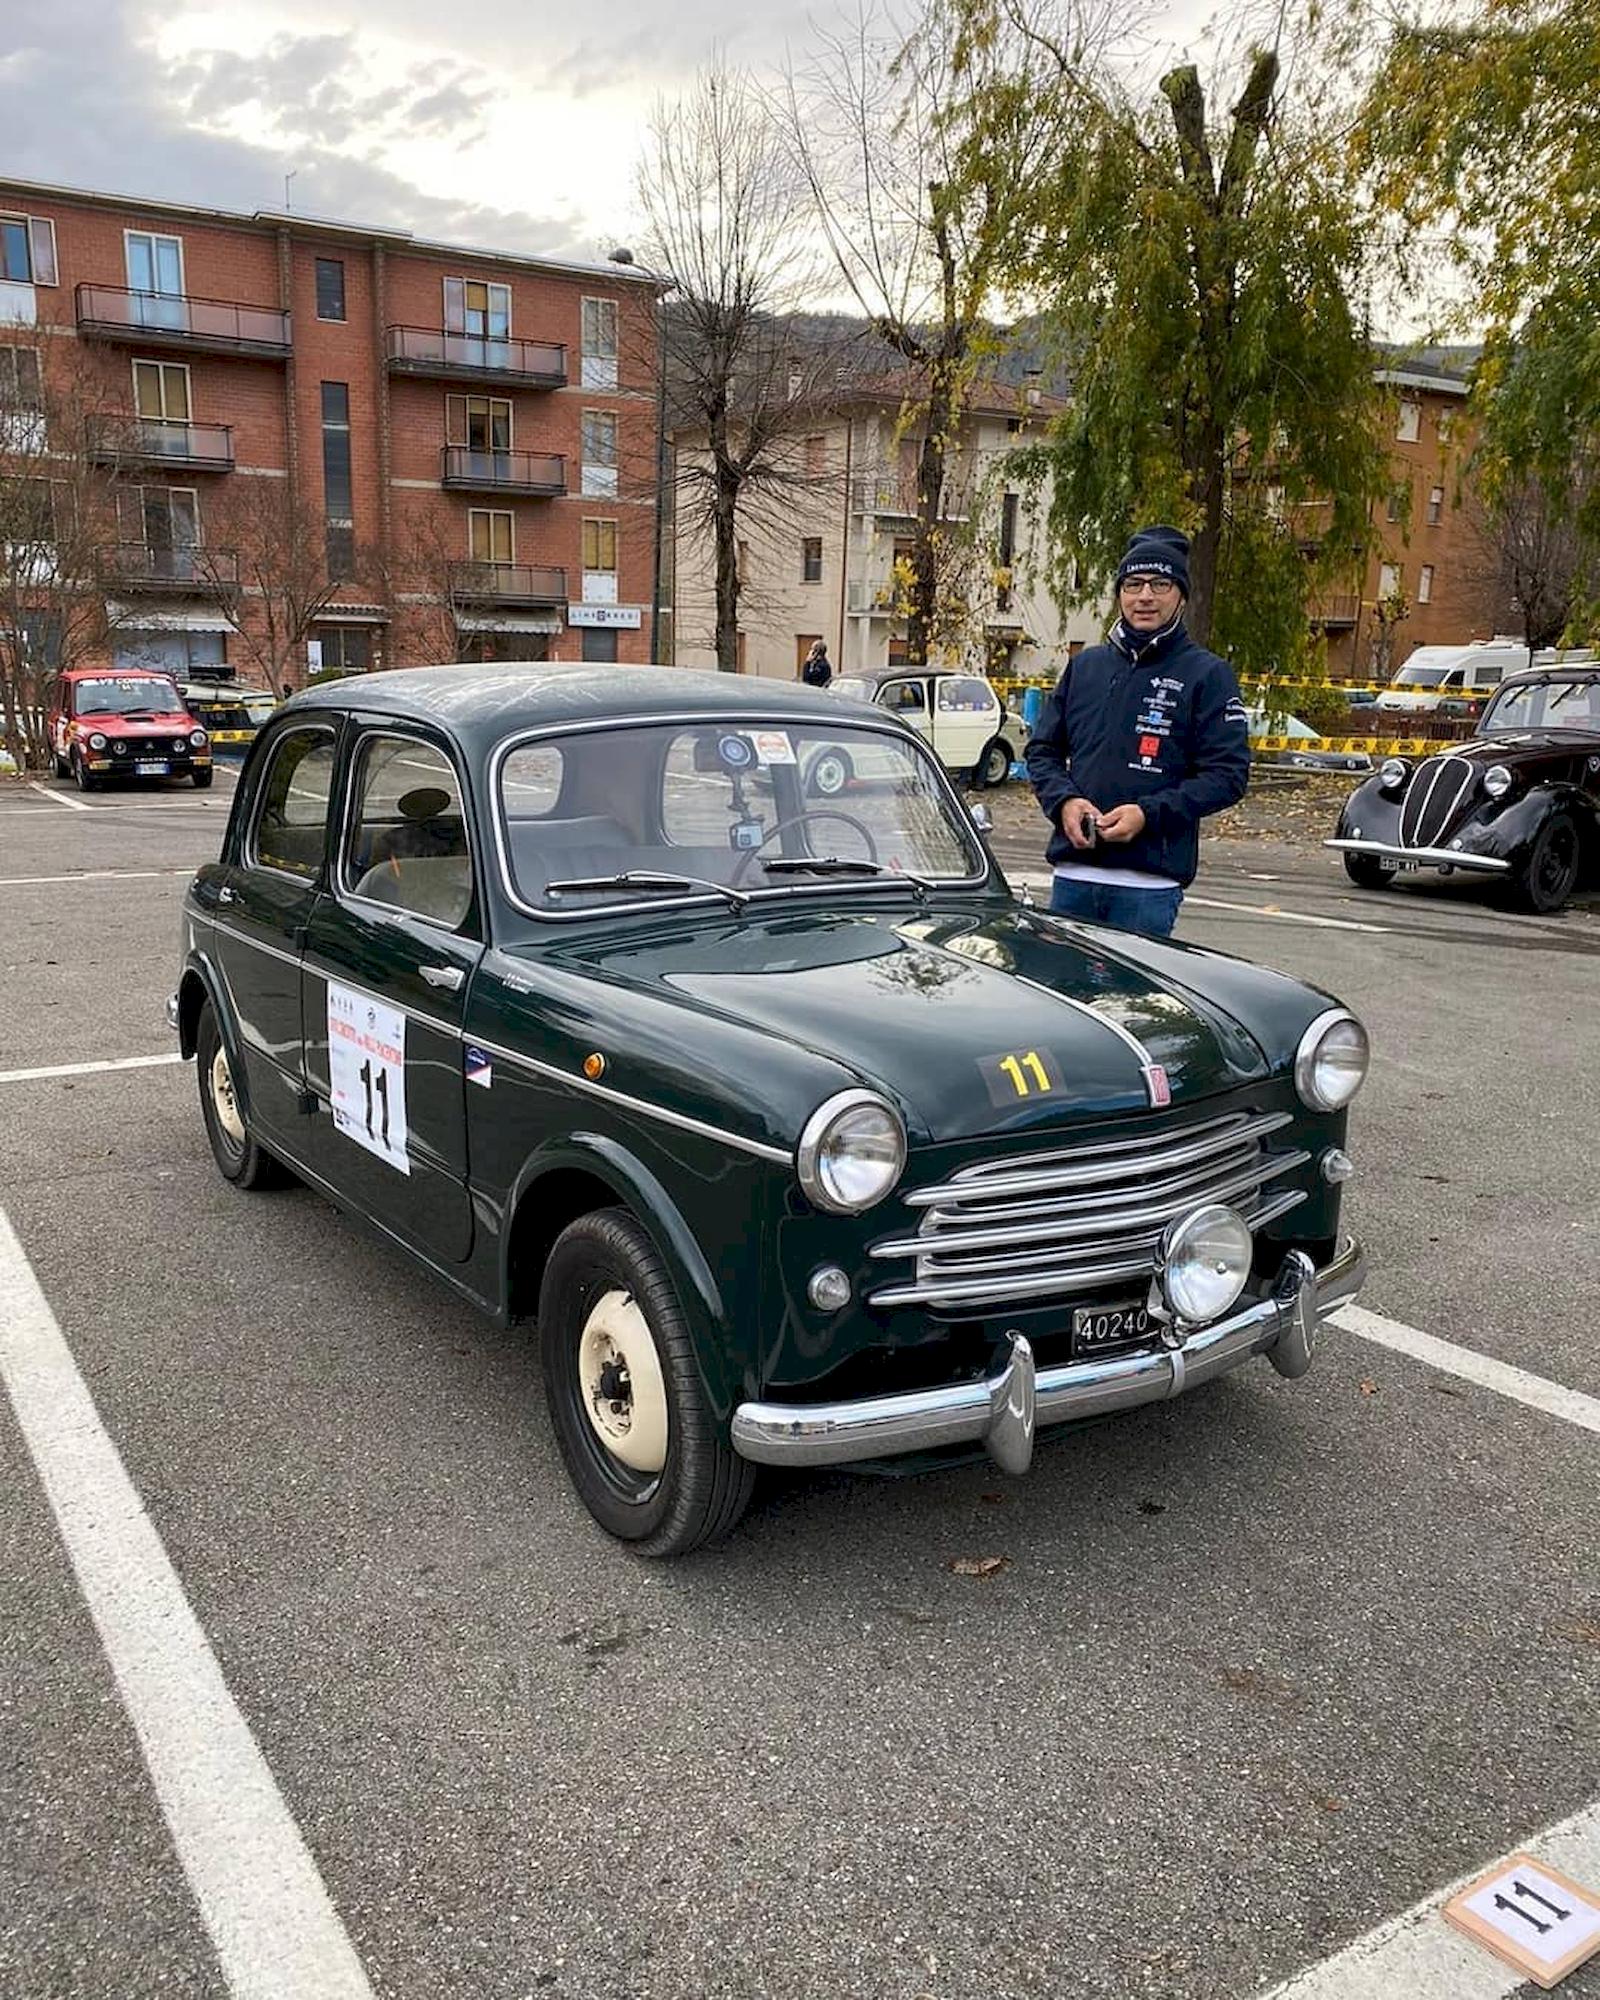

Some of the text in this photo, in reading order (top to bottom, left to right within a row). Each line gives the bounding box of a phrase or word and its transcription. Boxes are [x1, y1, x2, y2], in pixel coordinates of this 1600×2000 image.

[1000, 1051, 1052, 1097] 11
[359, 1058, 392, 1152] 11
[1080, 1311, 1148, 1340] 40240
[1494, 1881, 1572, 1934] 11
